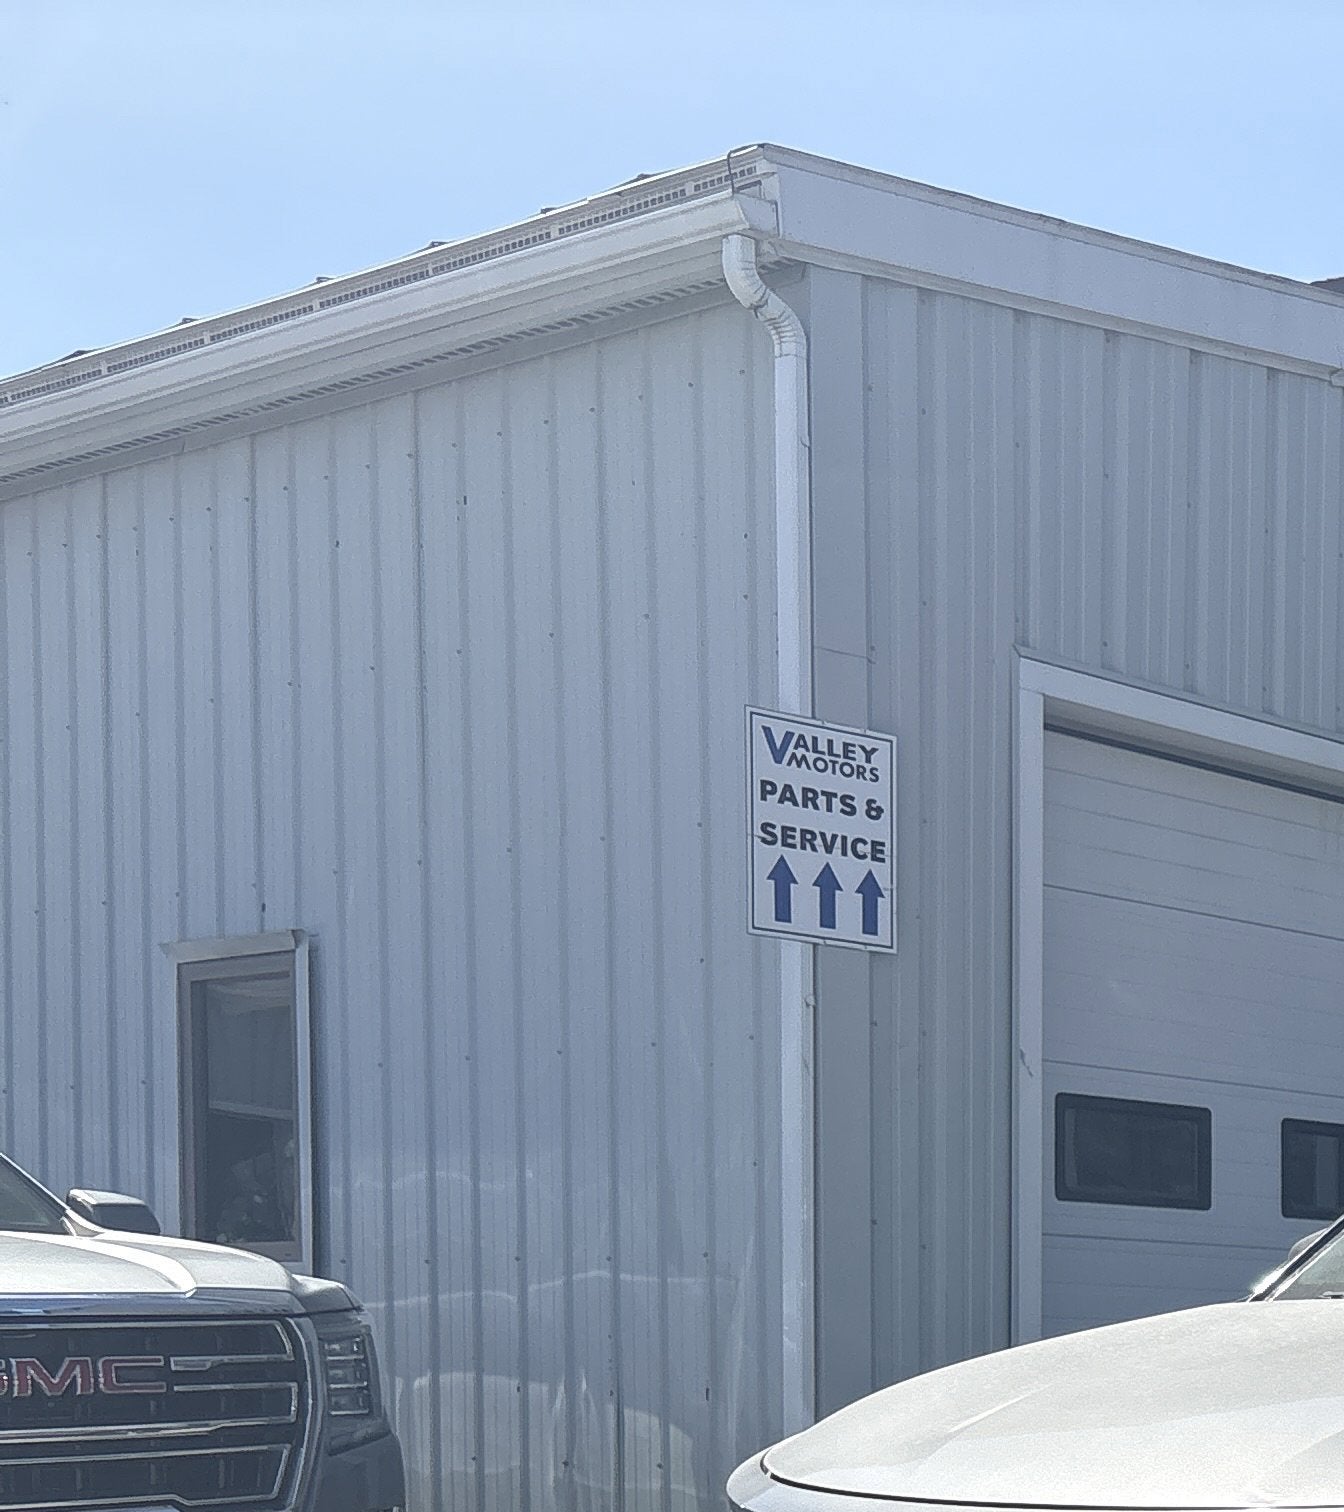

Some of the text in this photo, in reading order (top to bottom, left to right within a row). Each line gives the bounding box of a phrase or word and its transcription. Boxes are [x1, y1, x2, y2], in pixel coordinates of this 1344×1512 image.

[761, 725, 879, 764] VALLEY
[787, 751, 879, 783] MOTORS
[760, 779, 884, 820] PARTS &
[760, 822, 886, 863] SERVICE
[0, 1356, 166, 1397] MC
